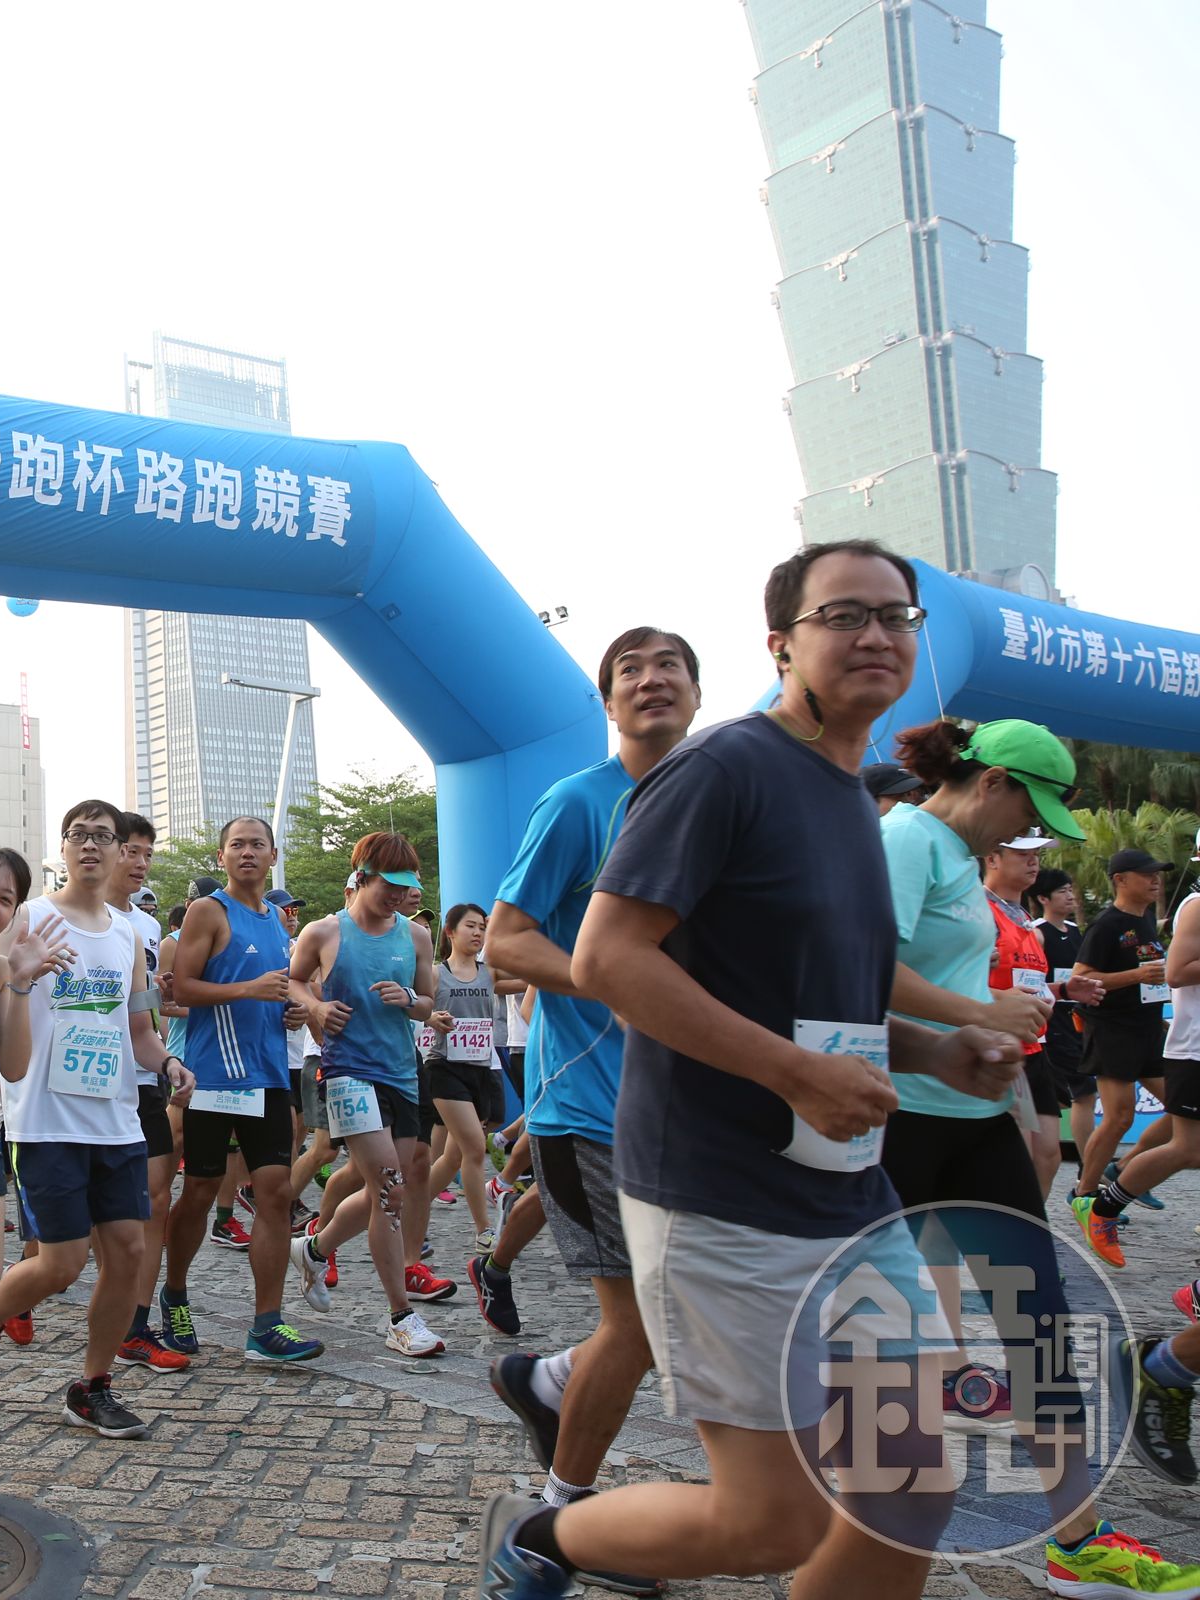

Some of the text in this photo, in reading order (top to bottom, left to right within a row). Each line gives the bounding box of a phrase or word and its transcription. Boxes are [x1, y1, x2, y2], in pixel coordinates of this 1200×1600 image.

[450, 988, 467, 998] JUST
[469, 988, 480, 997] DO
[450, 1034, 491, 1048] 11421
[63, 1048, 119, 1077] 5750
[1143, 1398, 1174, 1460] HOKA
